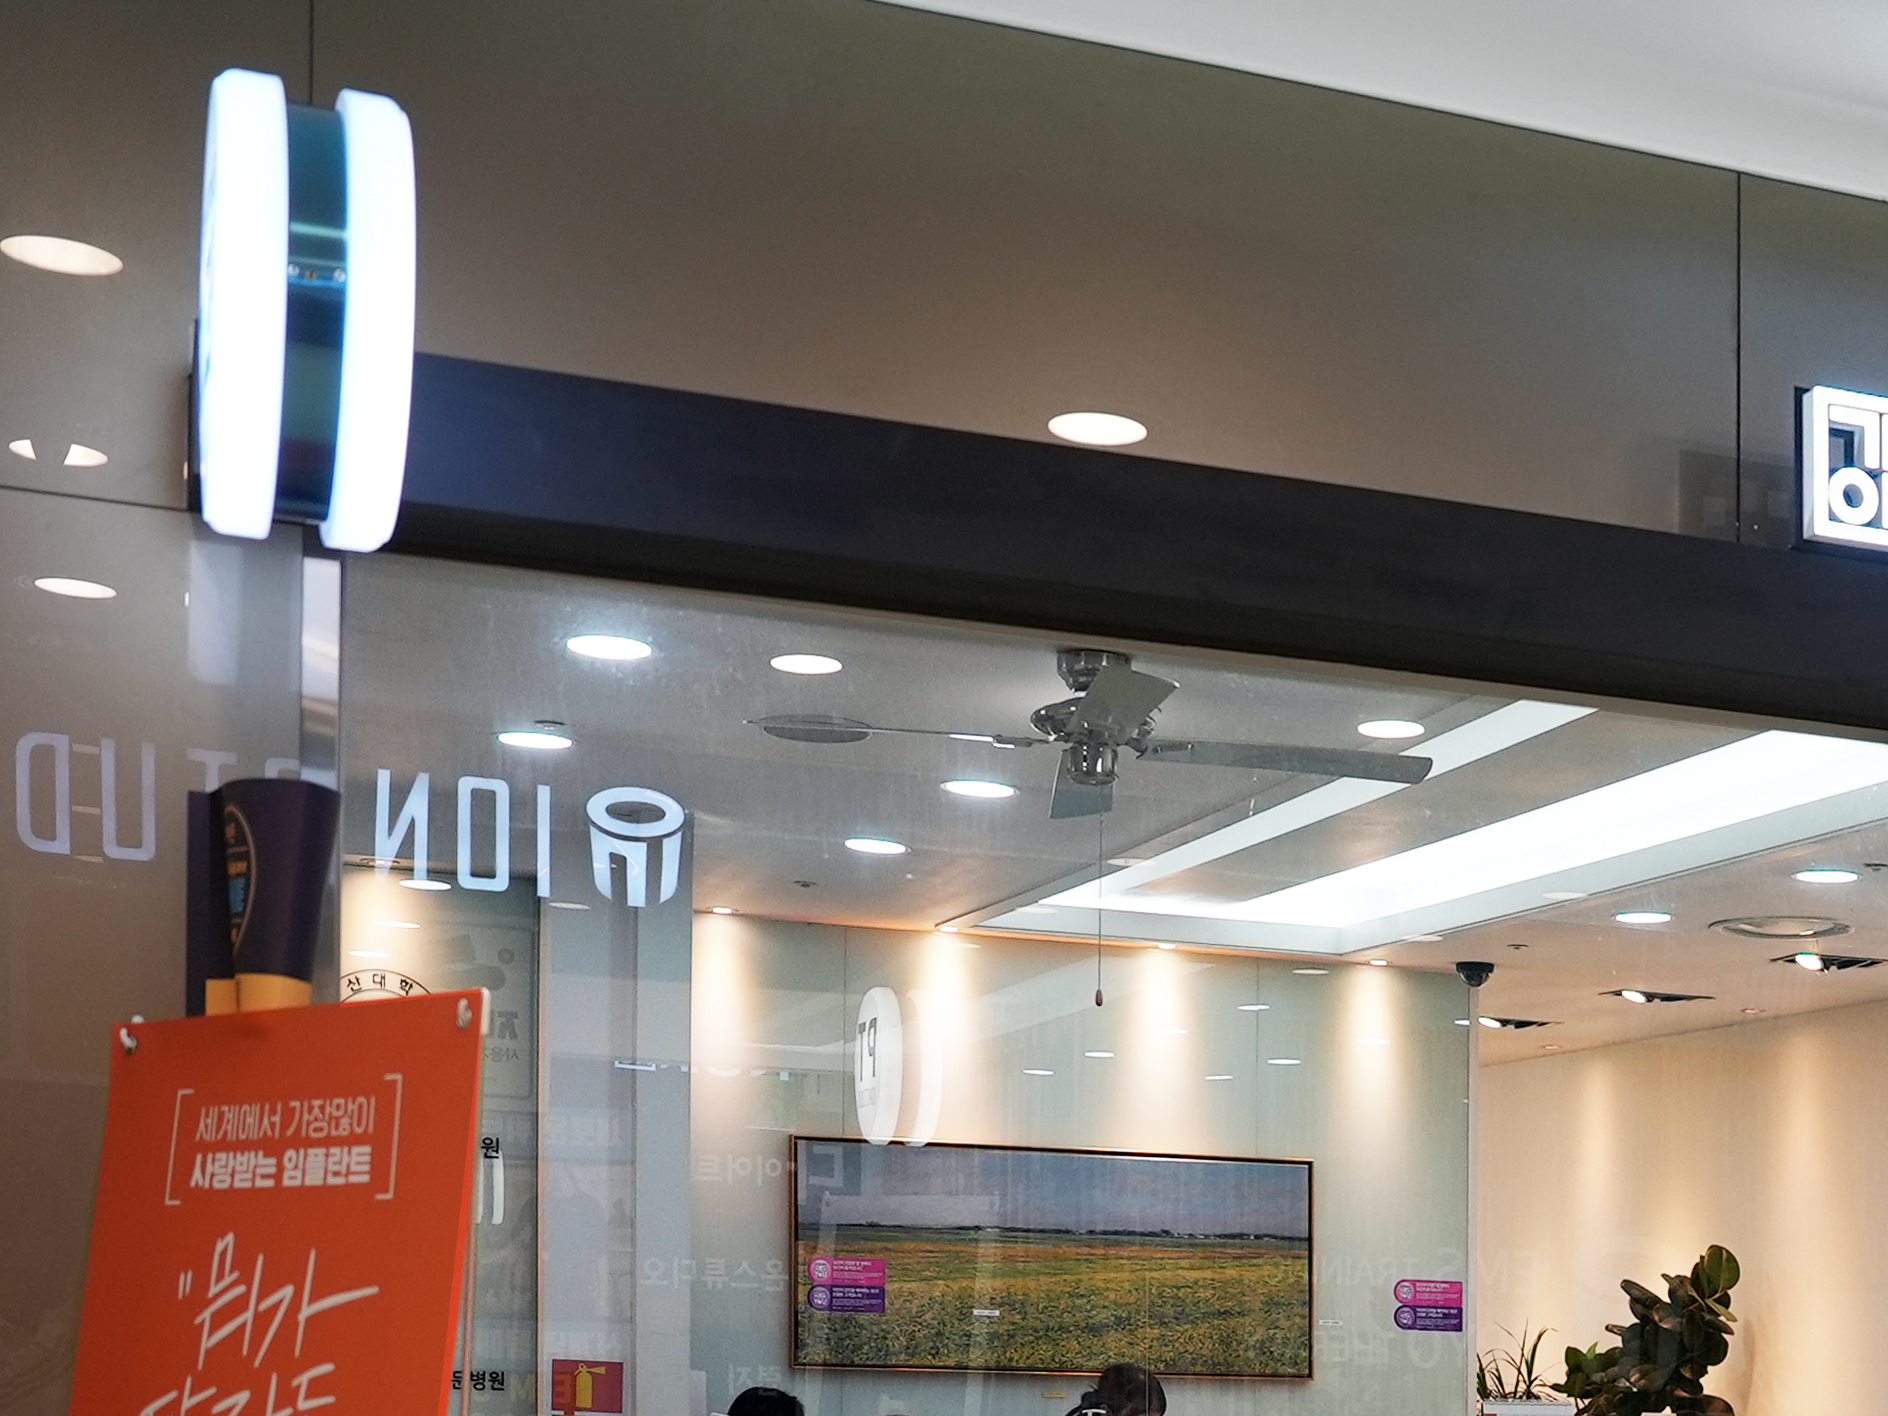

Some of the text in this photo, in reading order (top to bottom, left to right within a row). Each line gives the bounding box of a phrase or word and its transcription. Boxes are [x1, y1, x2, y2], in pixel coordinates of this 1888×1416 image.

[195, 1095, 376, 1143] 세계에서 가장많이
[189, 1145, 372, 1191] 사랑받는 임플란트
